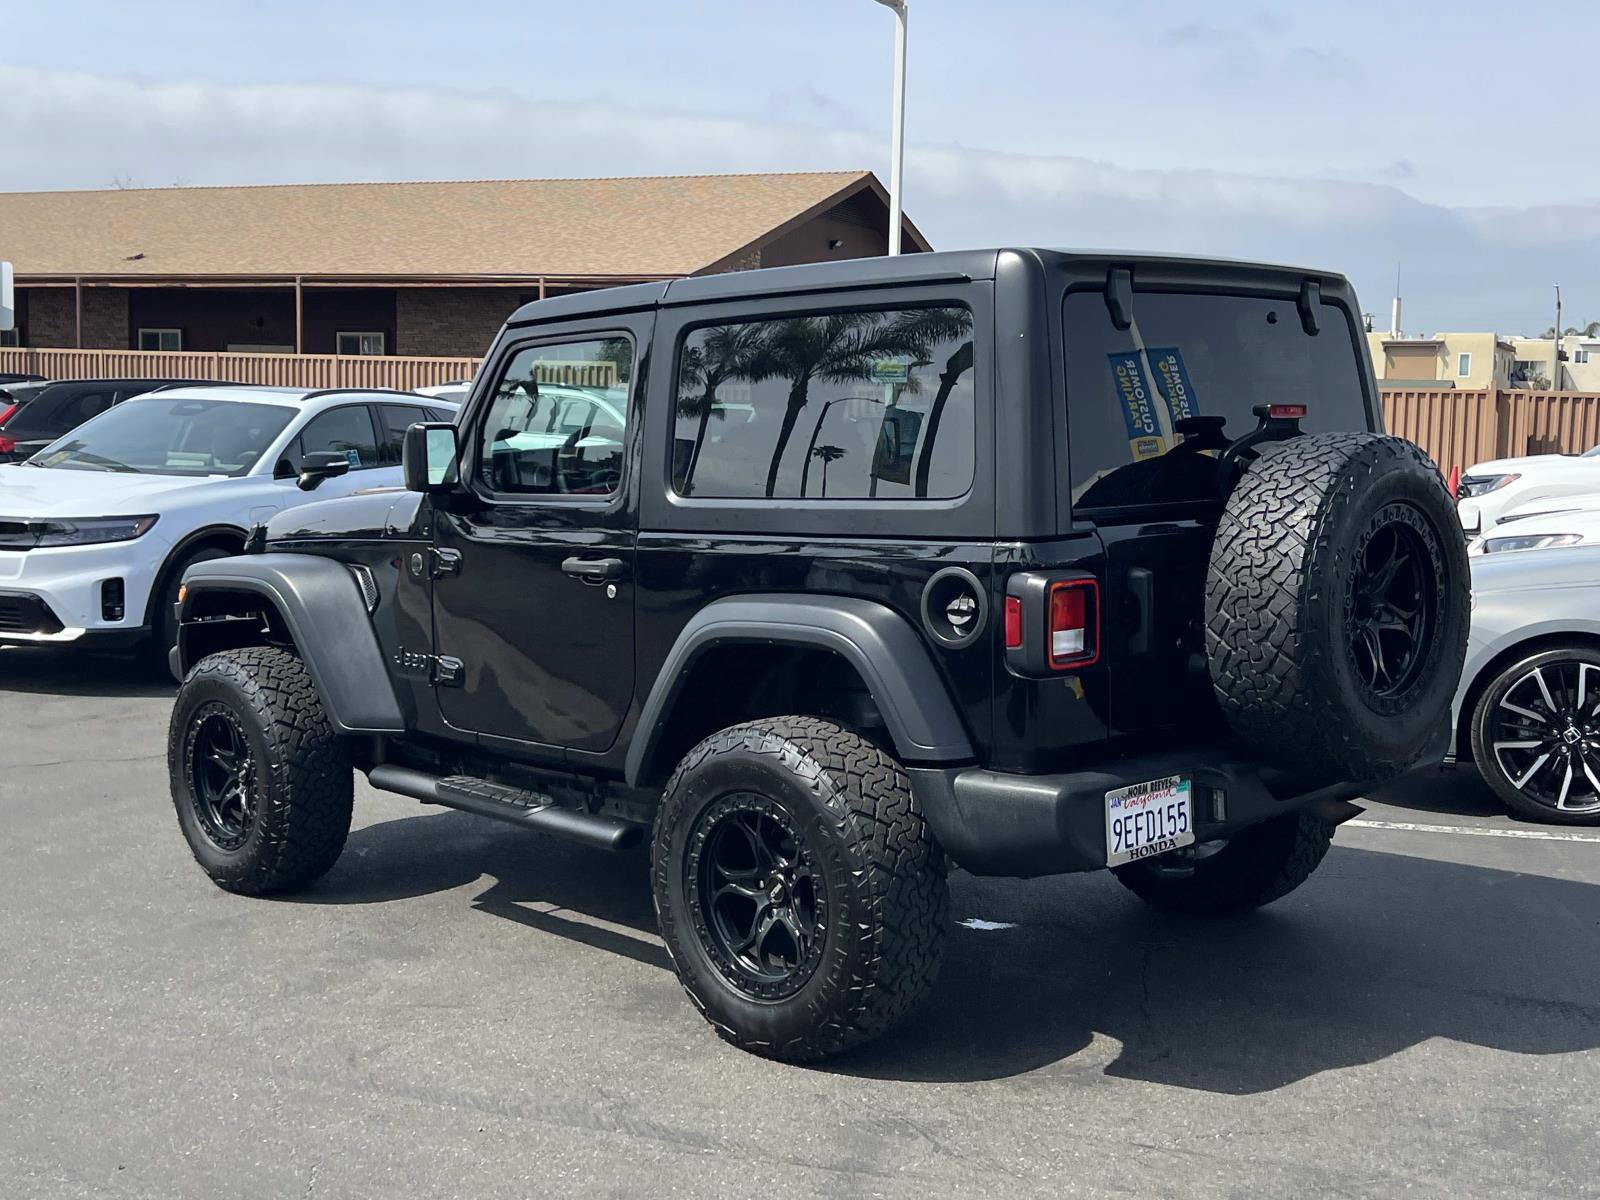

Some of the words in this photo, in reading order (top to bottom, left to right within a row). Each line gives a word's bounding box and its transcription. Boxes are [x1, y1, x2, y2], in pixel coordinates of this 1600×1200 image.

[394, 646, 428, 672] Jeep
[1128, 783, 1148, 797] NORM
[1150, 778, 1173, 792] REEVES
[1113, 801, 1187, 853] 9EFD155
[1130, 839, 1176, 859] HONDA
